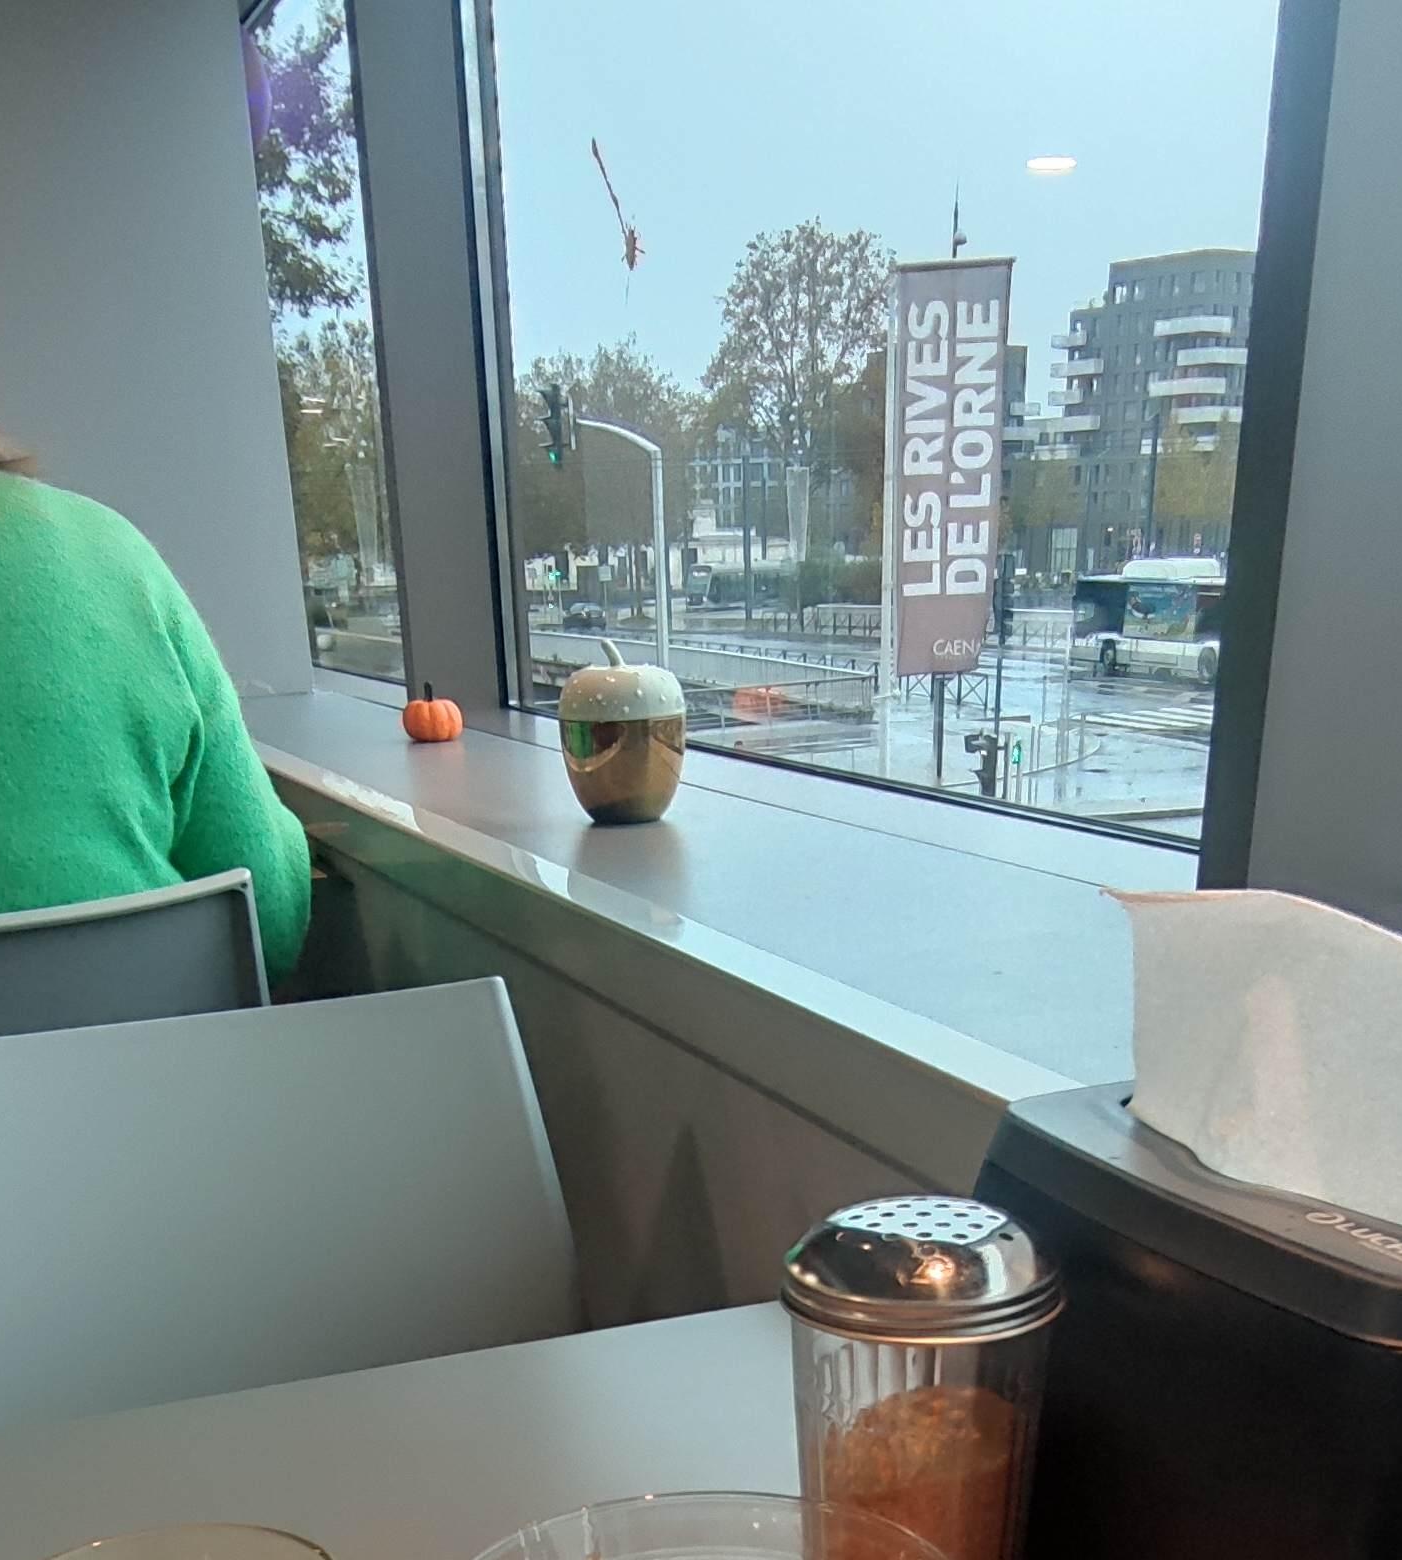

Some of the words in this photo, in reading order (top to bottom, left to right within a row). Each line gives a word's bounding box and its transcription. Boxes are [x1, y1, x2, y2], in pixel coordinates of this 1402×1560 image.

[904, 300, 949, 475] RIVES
[949, 300, 999, 508] L'ORNE
[902, 491, 942, 597] LES
[945, 520, 990, 596] DE
